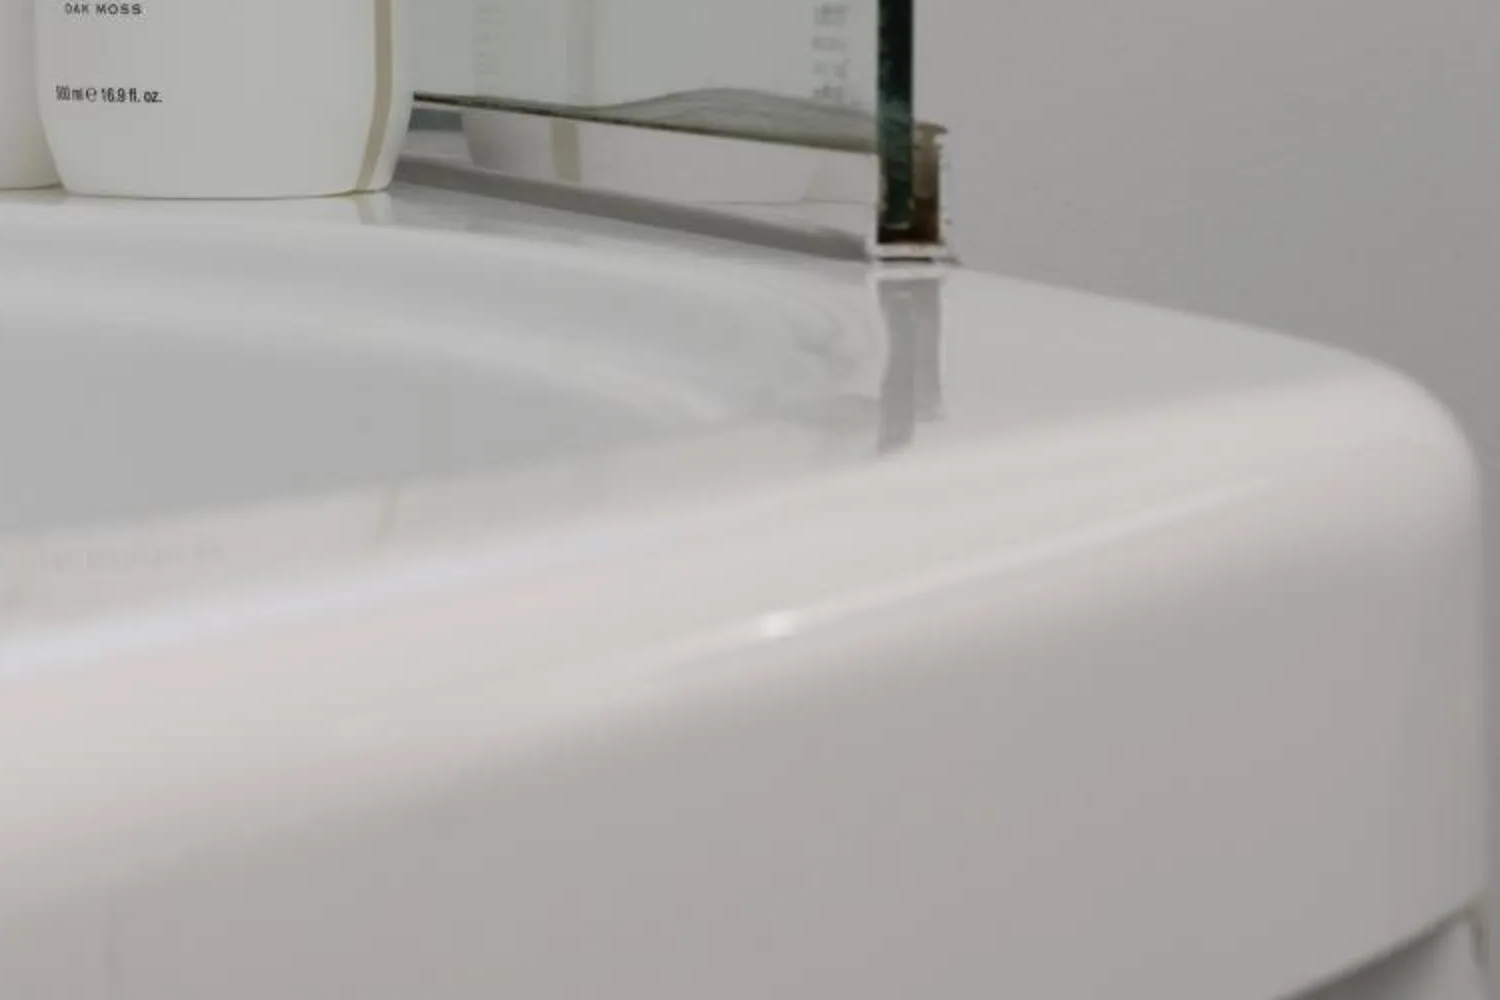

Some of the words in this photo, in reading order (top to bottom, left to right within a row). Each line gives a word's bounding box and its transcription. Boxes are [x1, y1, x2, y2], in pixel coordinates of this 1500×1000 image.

[64, 2, 89, 15] OAK
[96, 2, 142, 15] MOSS
[101, 87, 126, 103] 16.9
[143, 90, 163, 103] oz.
